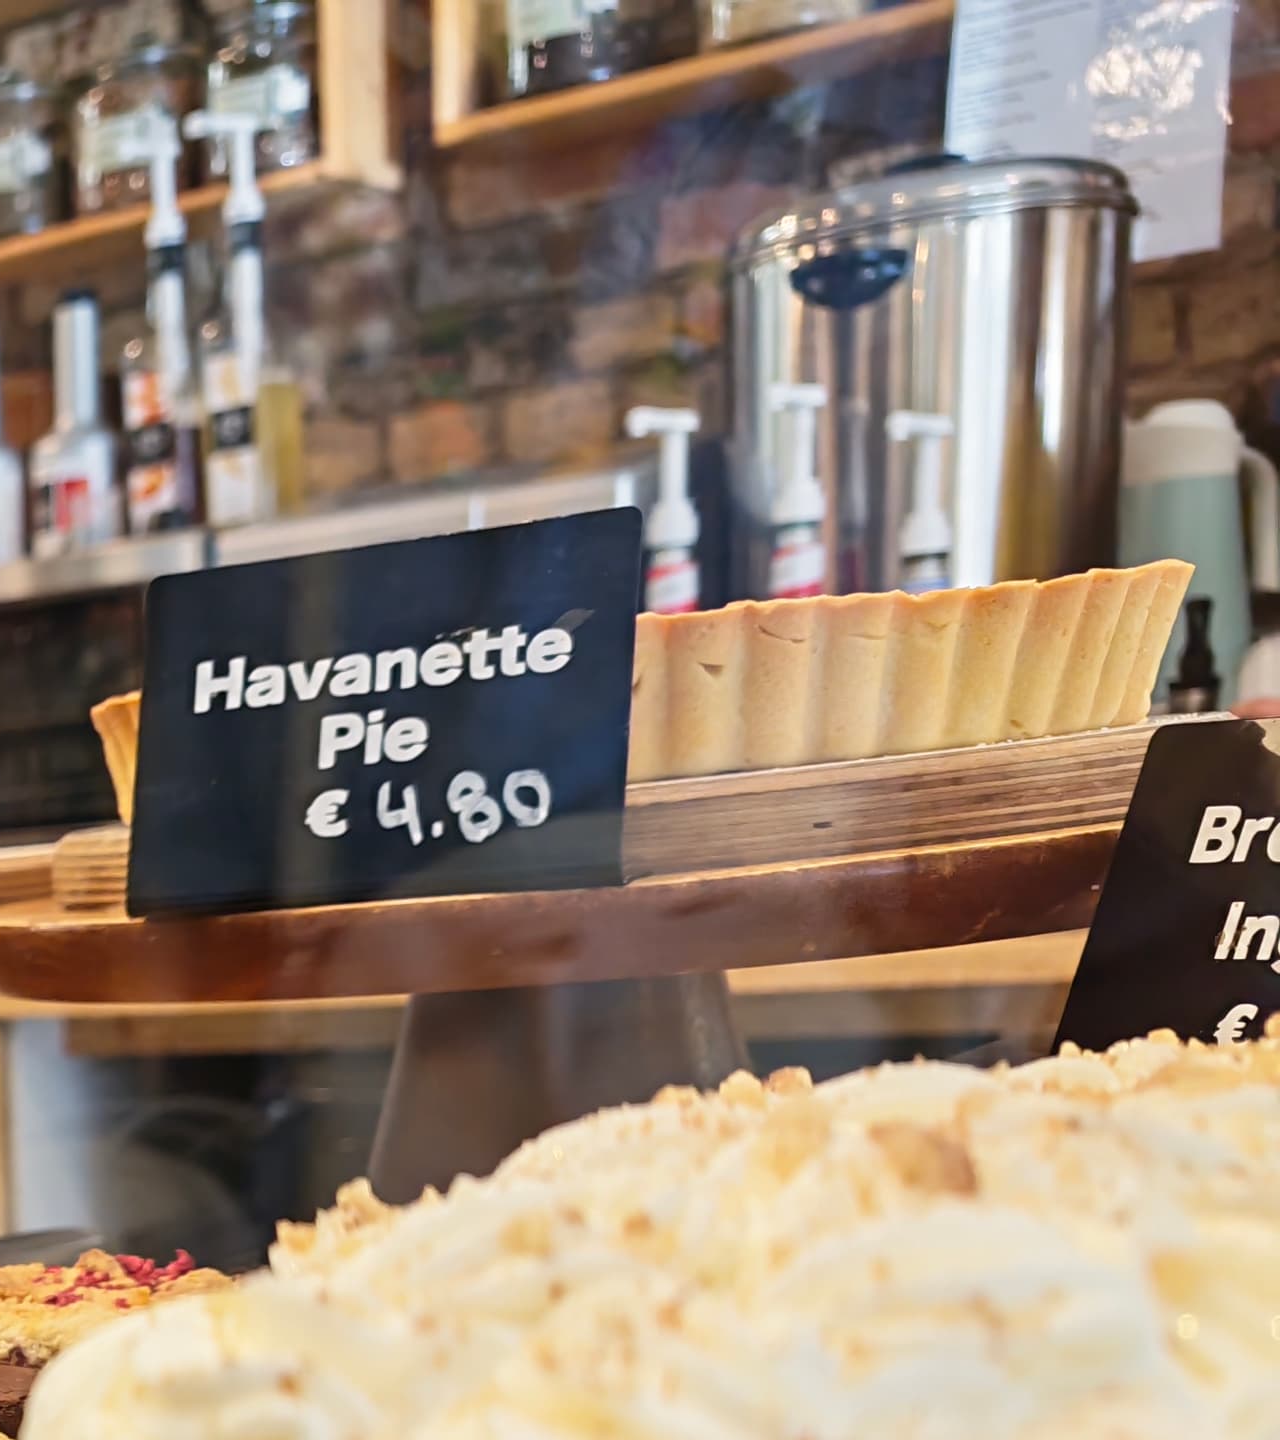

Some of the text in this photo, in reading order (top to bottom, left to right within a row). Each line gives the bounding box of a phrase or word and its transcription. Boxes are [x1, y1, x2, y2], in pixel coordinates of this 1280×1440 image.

[194, 625, 574, 713] Havanette
[318, 709, 430, 769] Pie
[376, 769, 552, 846] 4.80
